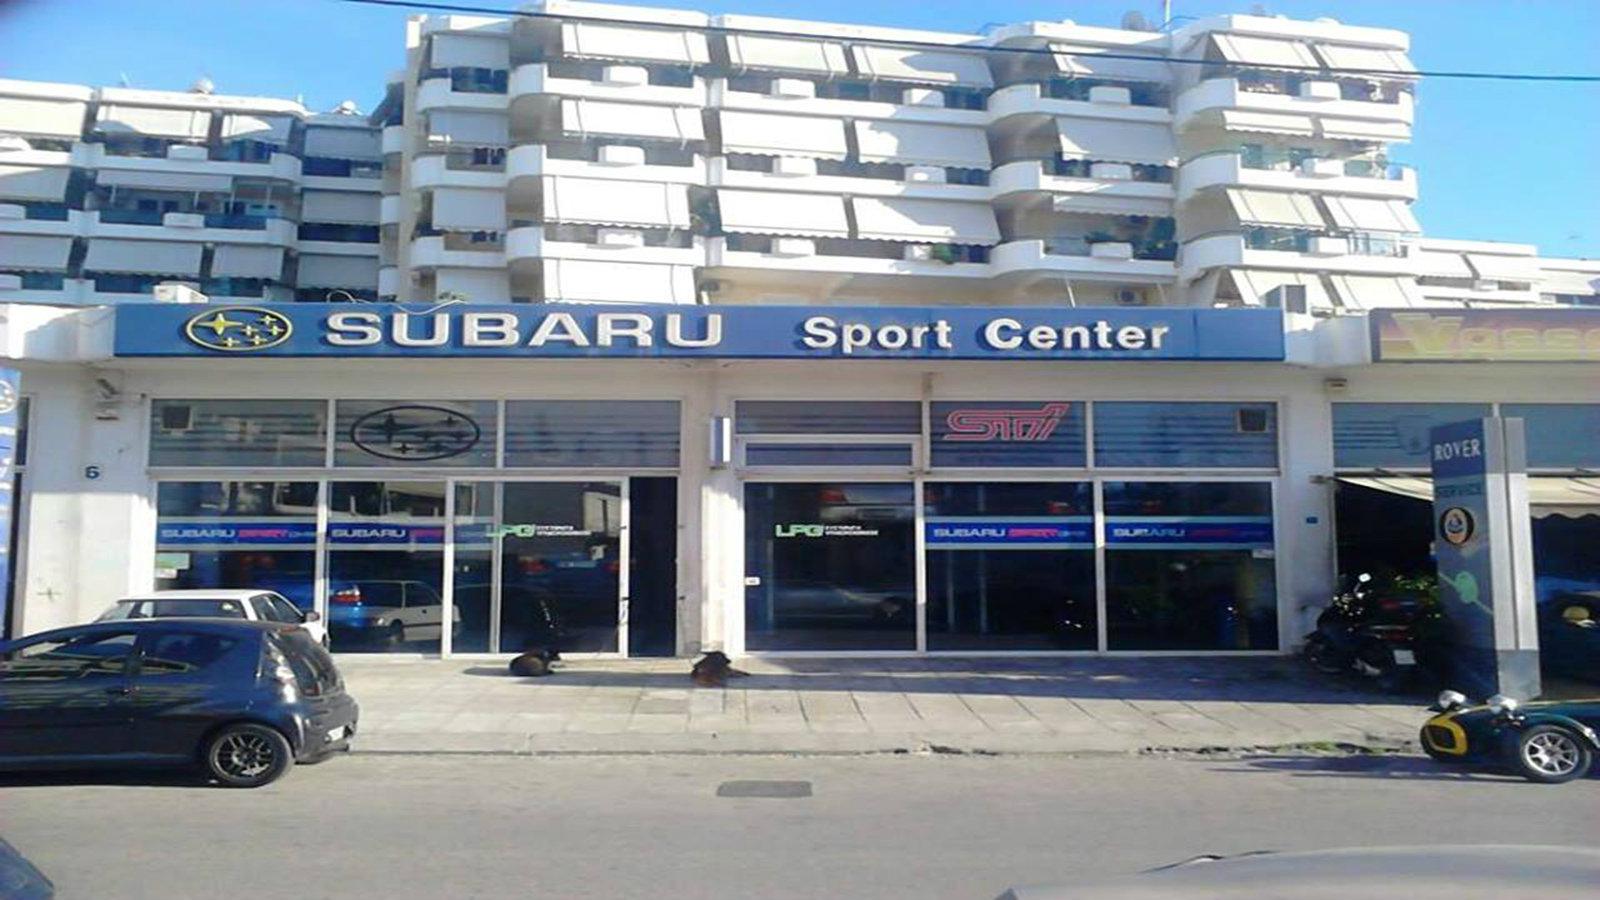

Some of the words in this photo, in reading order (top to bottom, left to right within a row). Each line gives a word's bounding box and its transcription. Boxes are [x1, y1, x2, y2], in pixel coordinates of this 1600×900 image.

[325, 312, 723, 348] SUBARU
[803, 316, 953, 354] Sport
[984, 318, 1169, 350] Center
[1433, 439, 1481, 460] ROVER
[161, 529, 235, 538] SUBARU
[331, 529, 406, 538] SUBARU
[776, 524, 824, 537] LPG
[934, 528, 1006, 537] SUBARU
[1113, 528, 1186, 537] SUBARU
